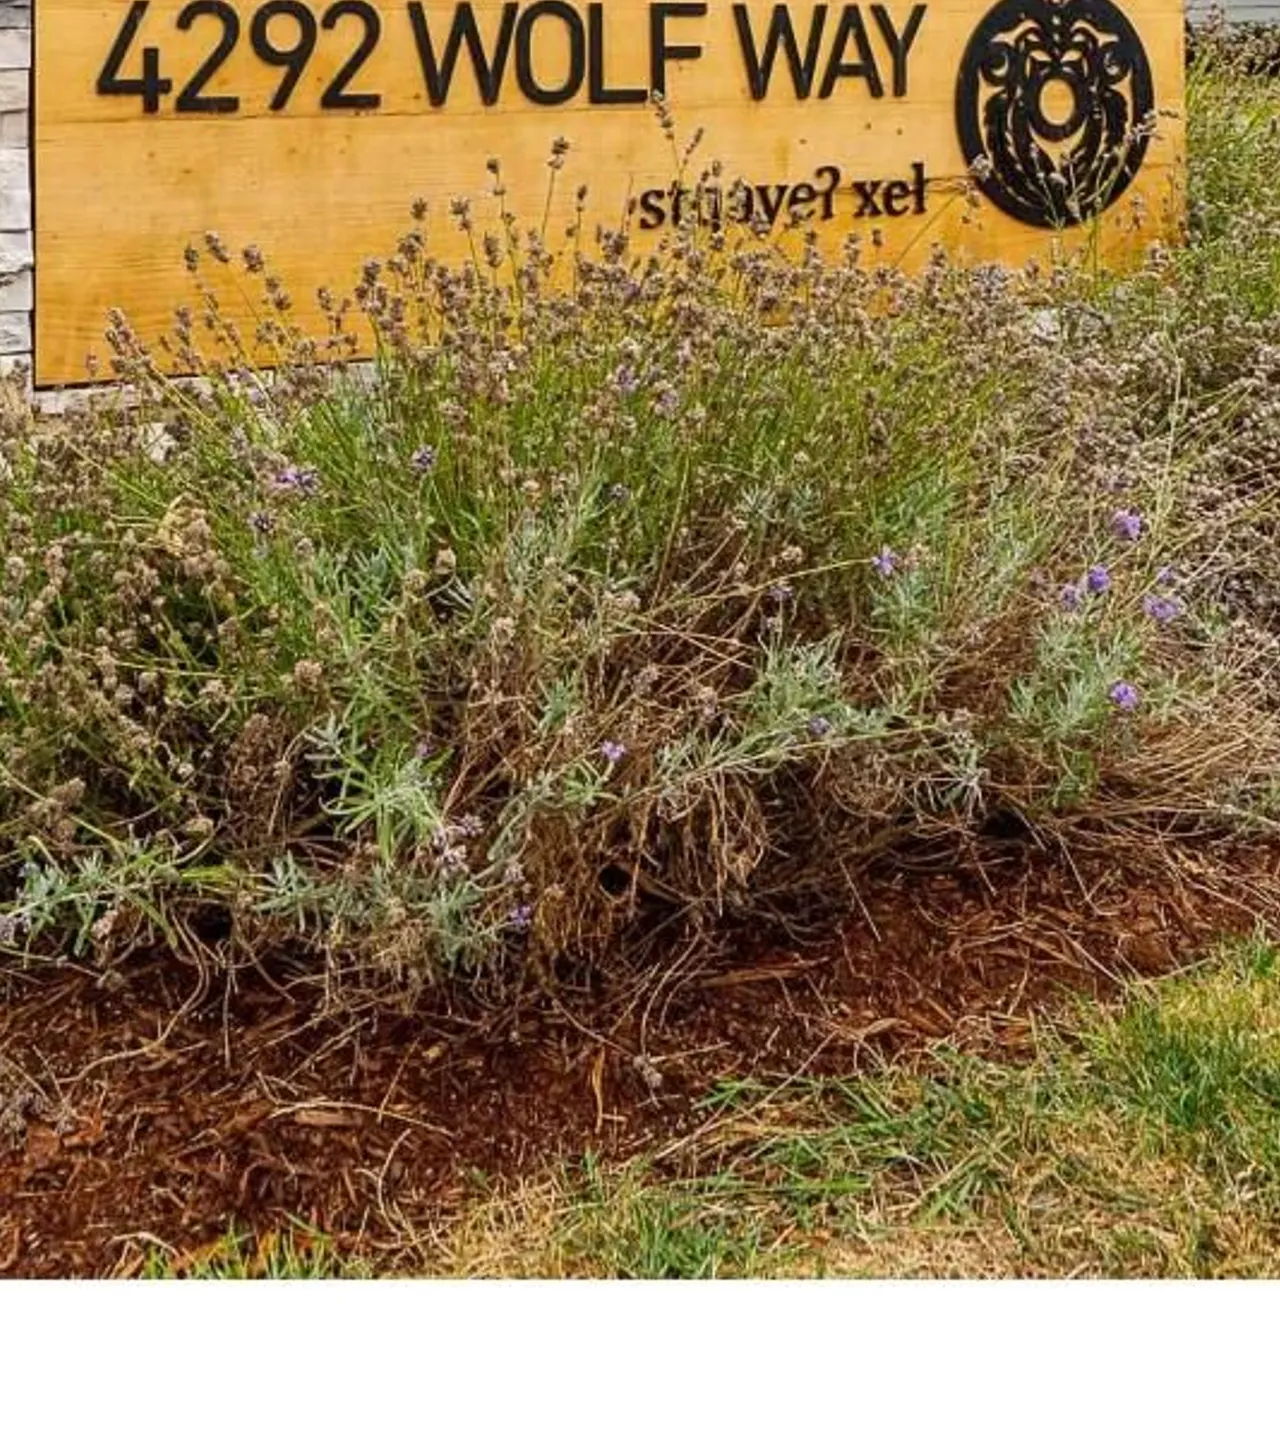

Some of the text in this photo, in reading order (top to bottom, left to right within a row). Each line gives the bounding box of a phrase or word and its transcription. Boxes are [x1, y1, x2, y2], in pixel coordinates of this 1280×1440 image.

[96, 0, 928, 114] 4292 WOLF WAY
